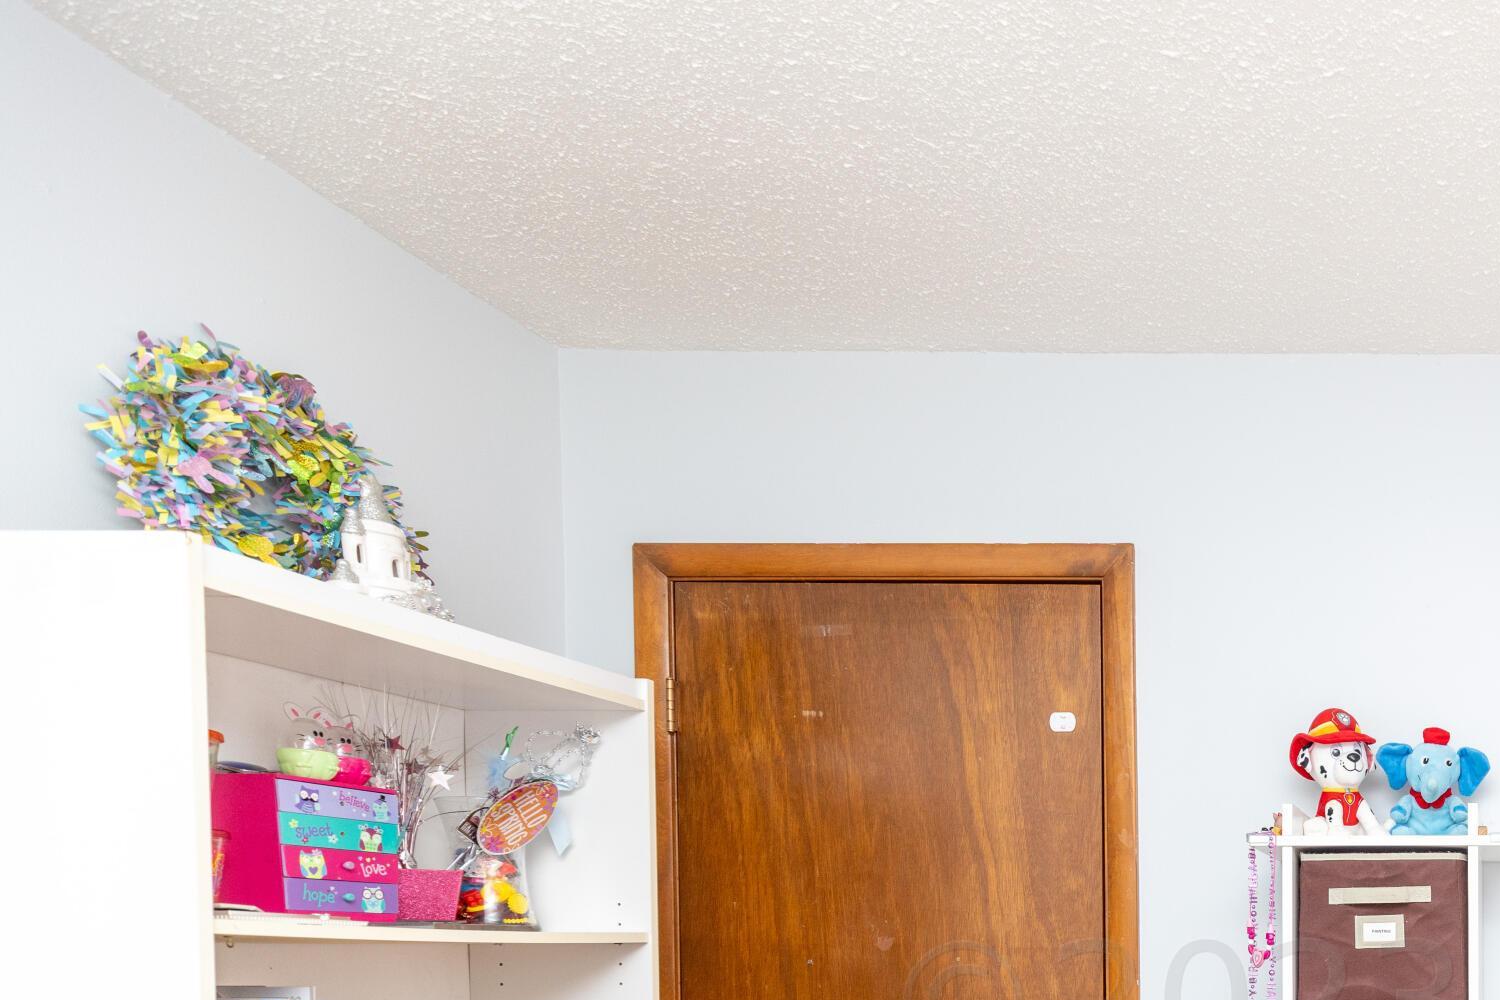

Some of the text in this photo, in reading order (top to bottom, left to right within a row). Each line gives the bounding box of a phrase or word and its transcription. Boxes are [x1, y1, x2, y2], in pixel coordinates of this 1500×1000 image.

[339, 790, 371, 813] believe
[512, 790, 548, 829] HELLO
[295, 822, 331, 839] sweet
[490, 802, 529, 846] SPRING
[361, 862, 388, 878] love
[303, 882, 335, 907] hope
